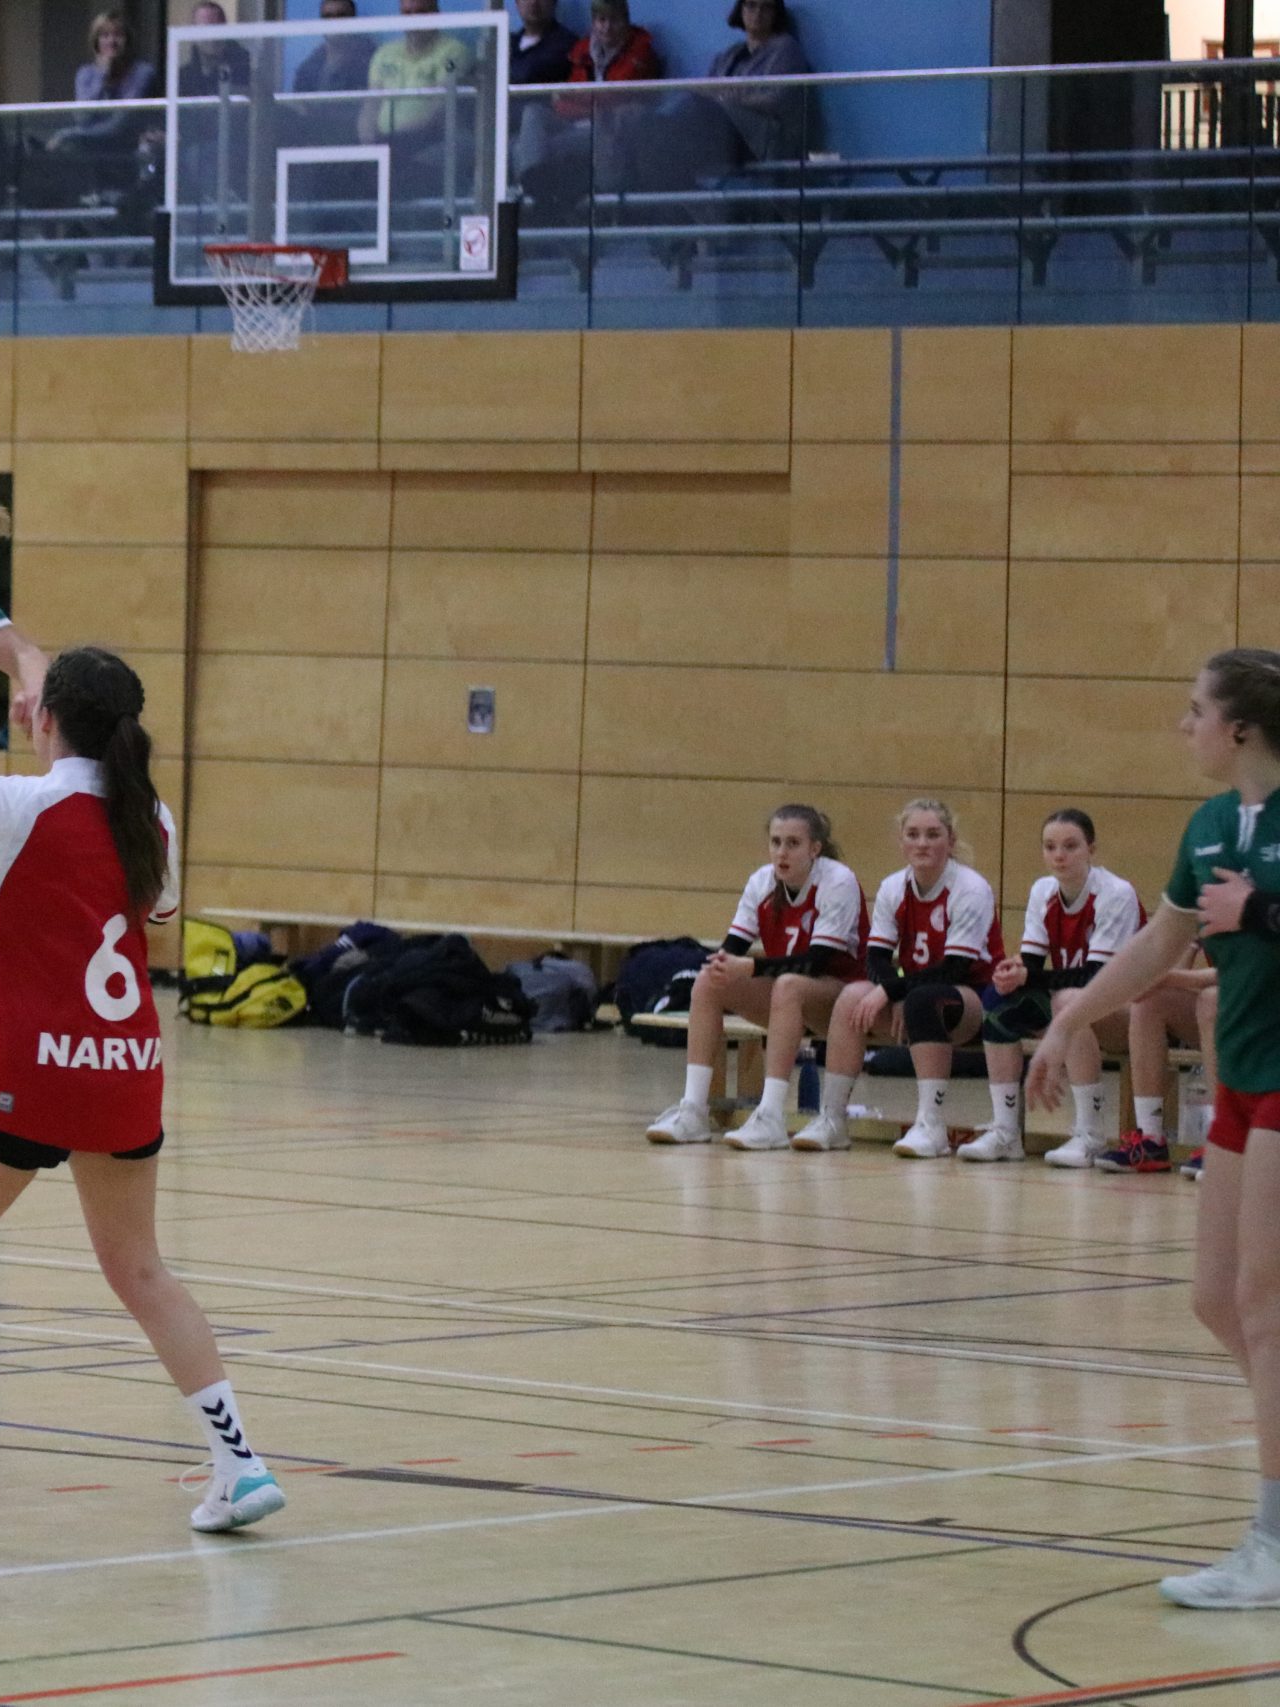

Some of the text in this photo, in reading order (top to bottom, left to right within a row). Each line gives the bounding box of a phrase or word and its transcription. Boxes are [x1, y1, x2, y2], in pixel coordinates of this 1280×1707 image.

[785, 926, 800, 957] 7
[912, 931, 930, 965] 5
[85, 913, 141, 1022] 6
